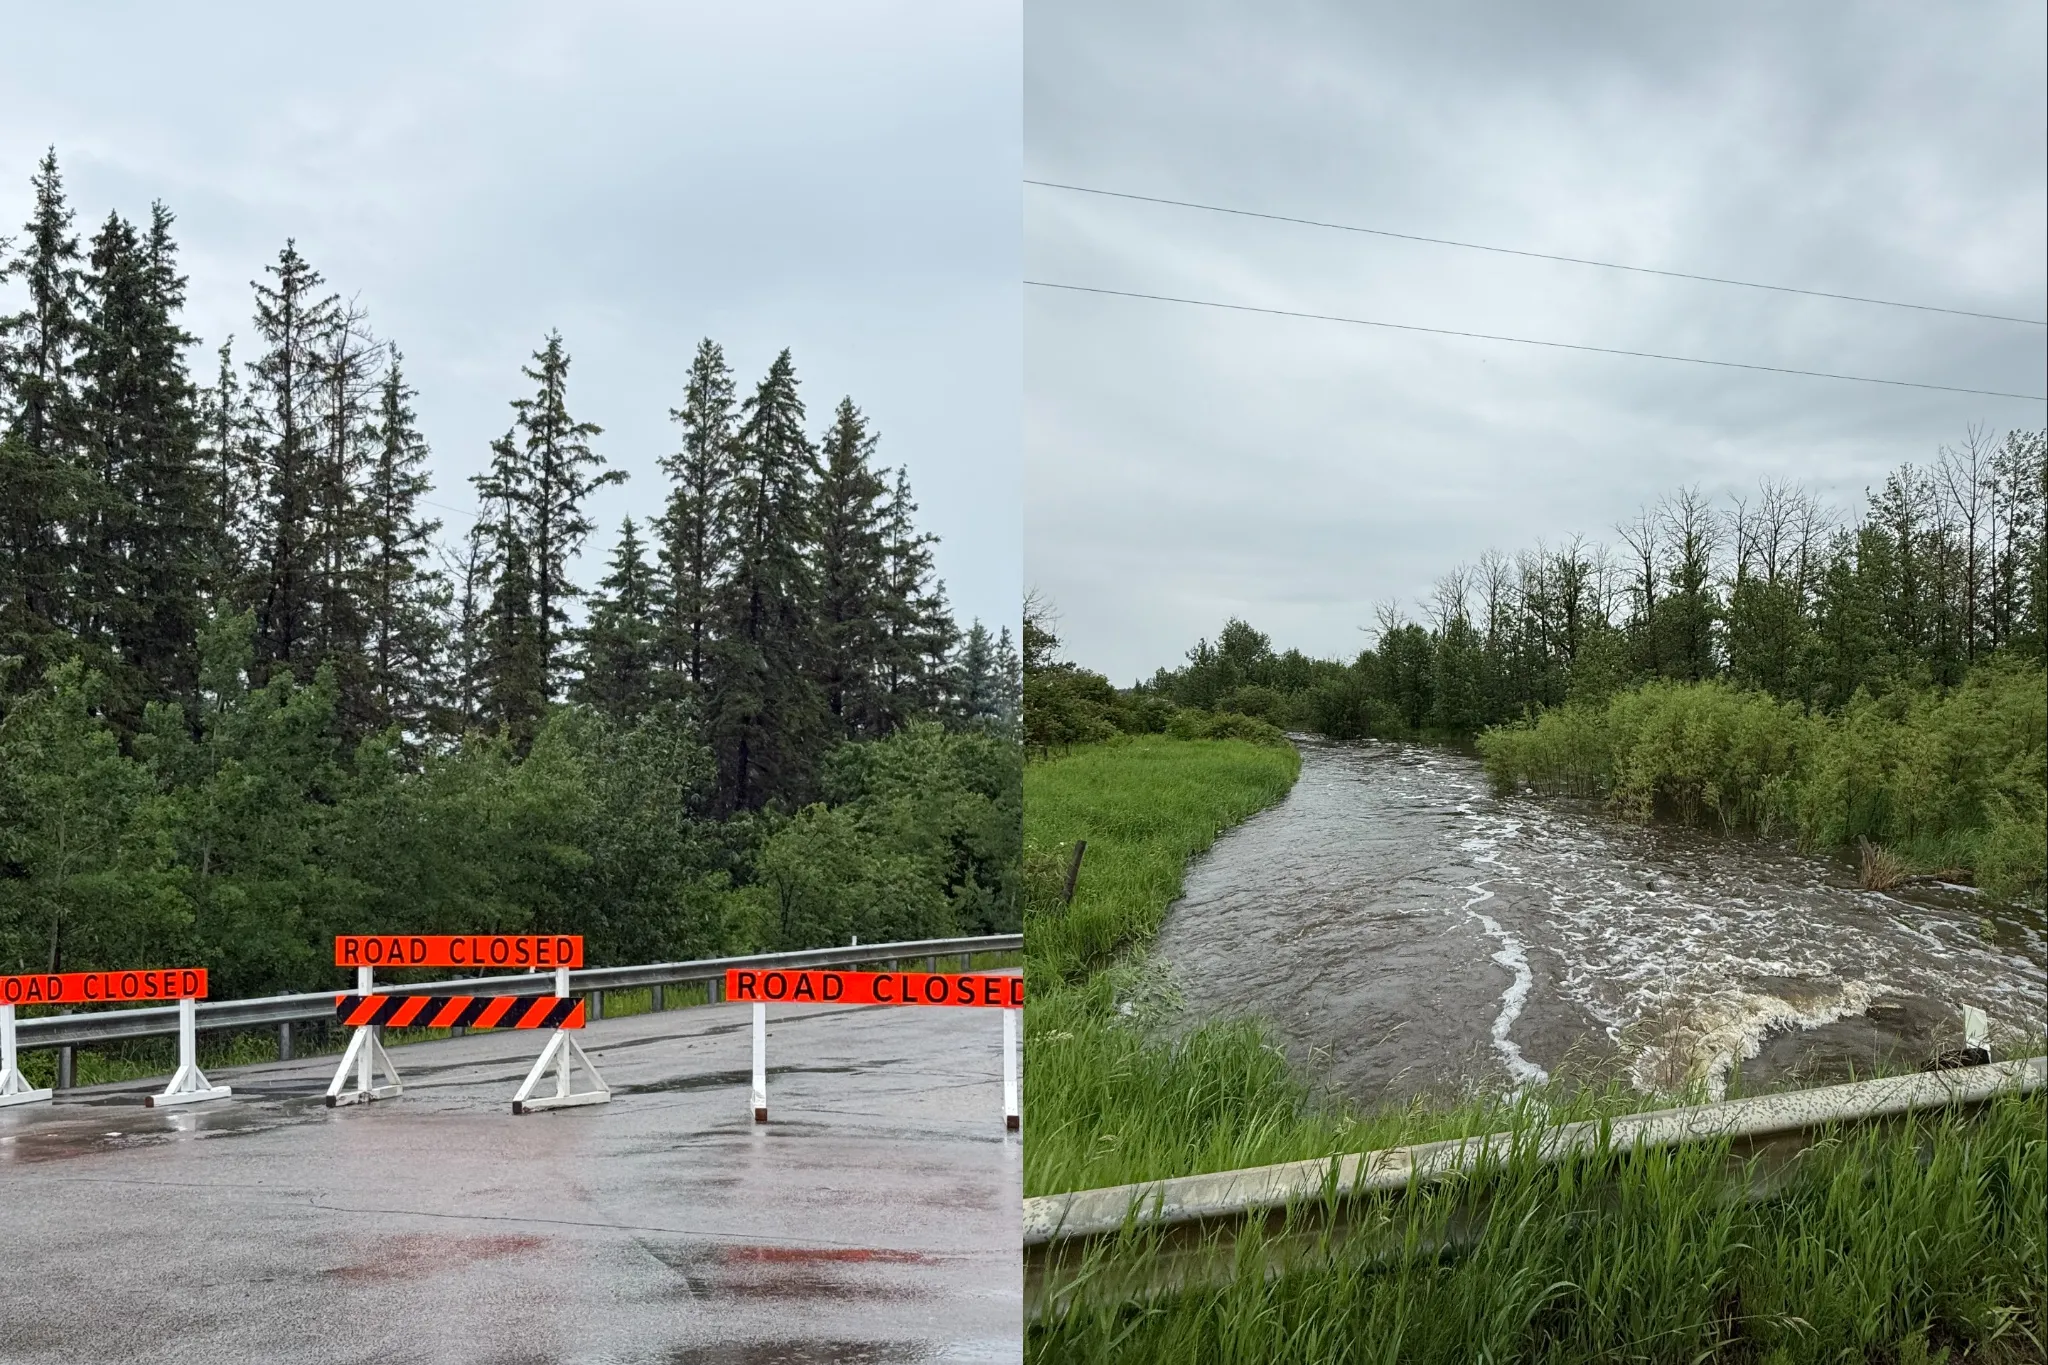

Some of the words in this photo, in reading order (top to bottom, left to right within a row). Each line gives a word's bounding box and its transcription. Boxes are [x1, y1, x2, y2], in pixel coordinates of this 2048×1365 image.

[344, 938, 427, 964] ROAD
[449, 938, 574, 964] CLOSED
[4, 976, 63, 1003] OAD
[83, 971, 199, 999] CLOSED
[737, 972, 844, 1001] ROAD
